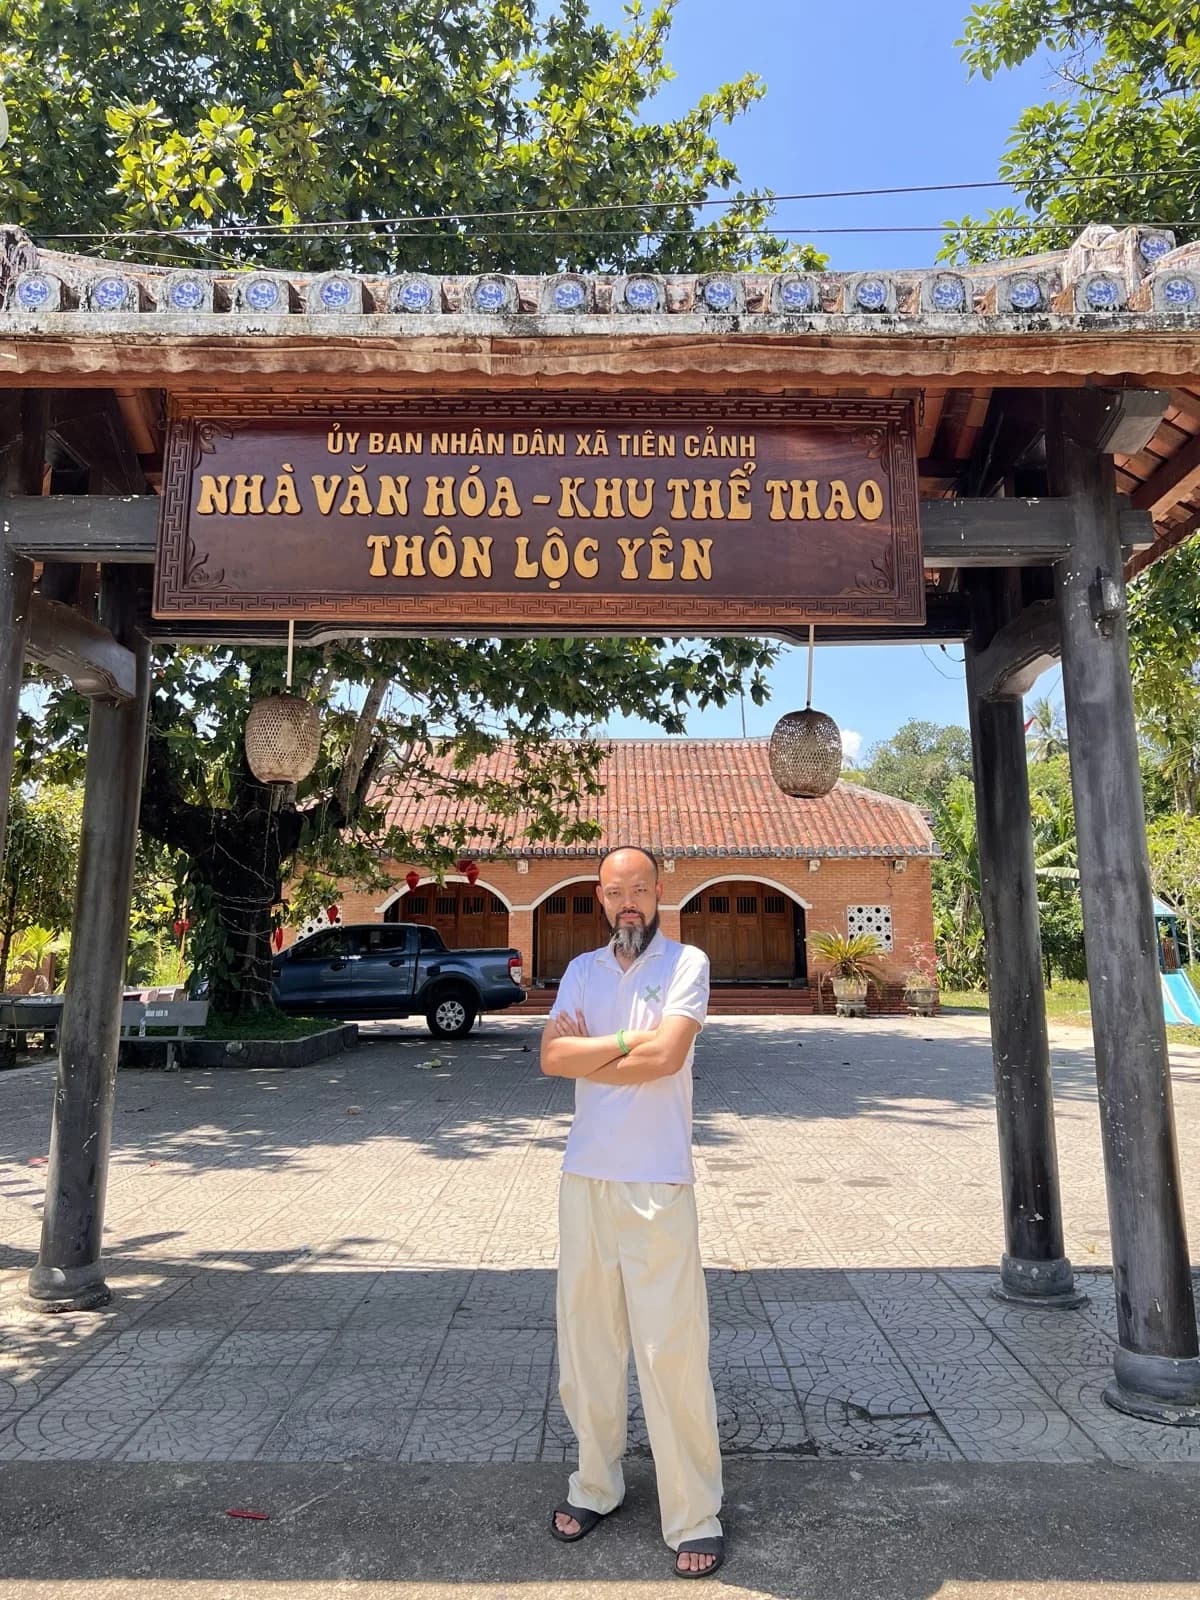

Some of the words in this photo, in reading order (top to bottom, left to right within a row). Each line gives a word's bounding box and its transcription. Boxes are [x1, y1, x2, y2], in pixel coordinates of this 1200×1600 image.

[327, 423, 360, 454] ỦY
[368, 432, 422, 454] BAN
[431, 427, 504, 455] NHÂN
[512, 428, 565, 455] DÂN
[575, 430, 609, 456] XÃ
[617, 428, 675, 456] TIÊN
[684, 425, 756, 457] CẢNH
[196, 462, 301, 515] NHÀ
[311, 461, 409, 516] VĂN
[422, 463, 522, 517] HÓA
[667, 460, 757, 520] THỂ
[765, 479, 883, 521] THAO
[366, 526, 493, 578] THÔN
[513, 526, 599, 589] LỘC
[617, 526, 713, 580] YÊN
